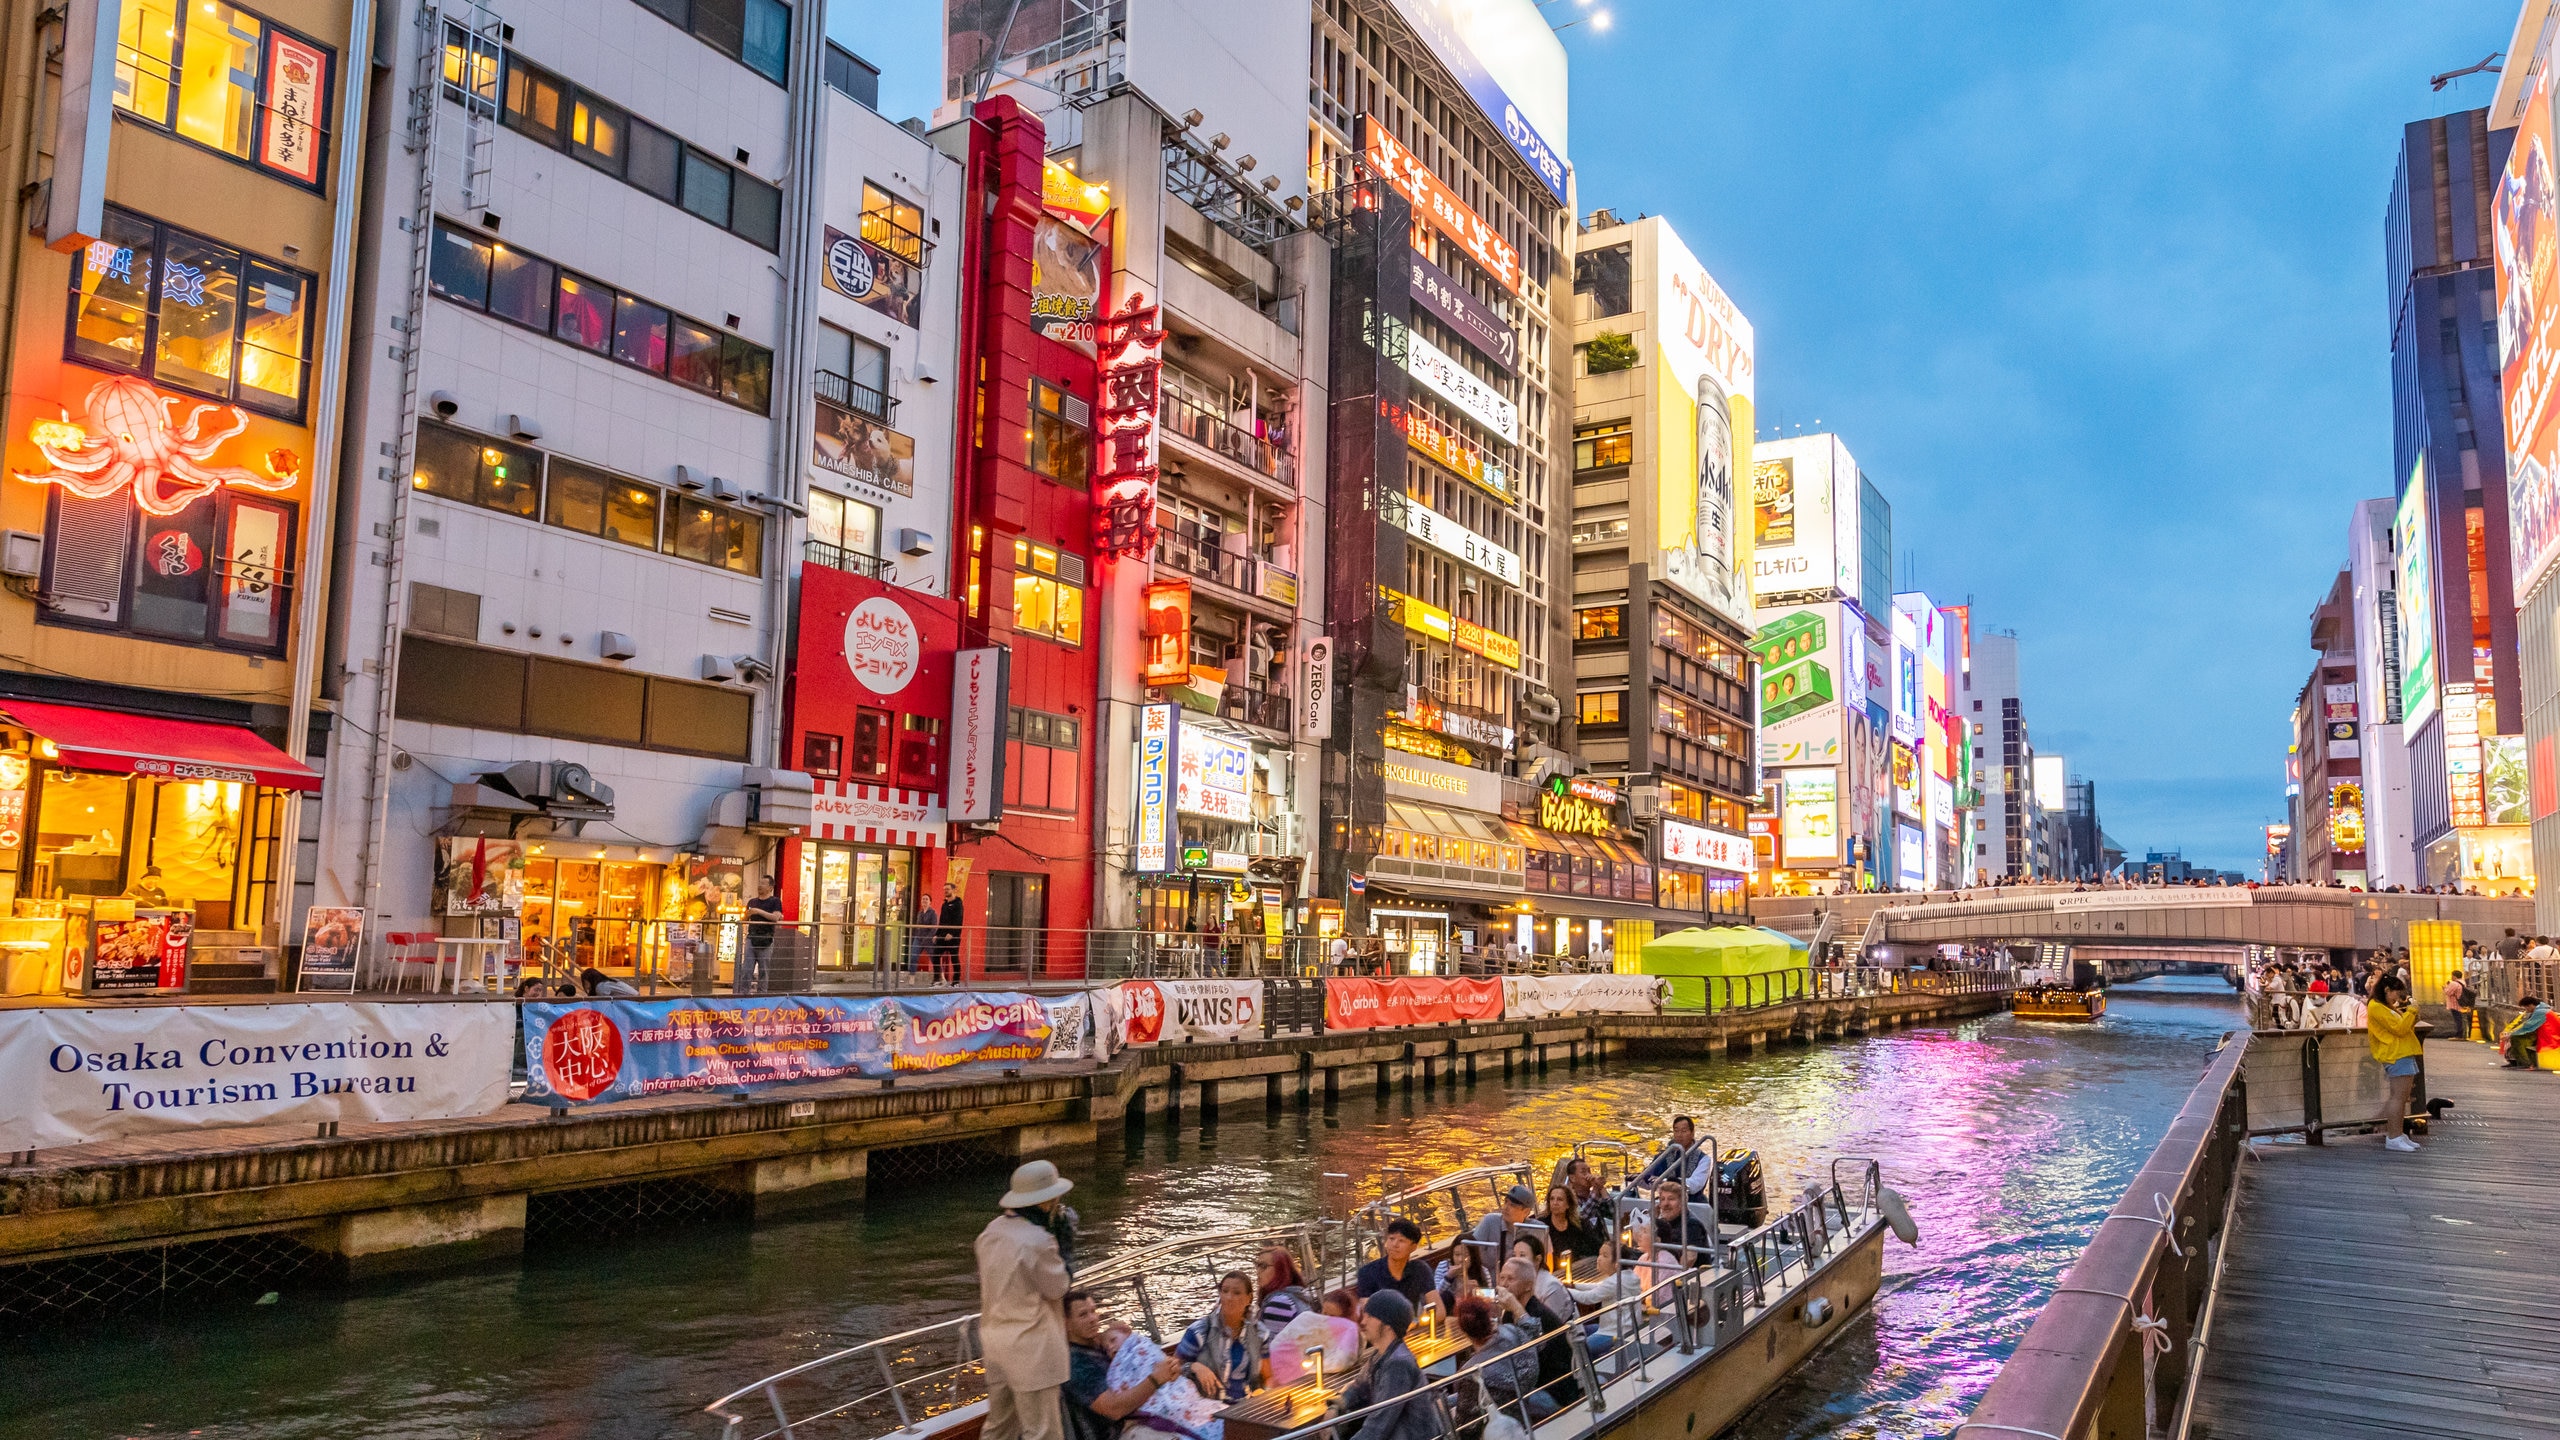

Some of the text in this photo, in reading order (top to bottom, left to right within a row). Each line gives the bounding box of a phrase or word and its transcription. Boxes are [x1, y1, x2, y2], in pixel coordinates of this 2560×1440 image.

[277, 87, 299, 163] まねき多幸
[1518, 119, 1562, 190] フジ住宅
[1433, 191, 1465, 235] 居楽屋
[1699, 272, 1733, 327] SUPER
[817, 454, 911, 496] MAMESHIBA CAFE
[1699, 449, 1732, 511] Asahi
[1711, 510, 1721, 532] 生
[1465, 533, 1507, 578] 白木屋
[236, 592, 266, 604] KUKURU
[856, 611, 909, 638] よしもと
[856, 631, 909, 658] エンタメ
[854, 652, 908, 679] ショップ
[1310, 663, 1322, 701] ZERO
[963, 653, 981, 815] よしもとエンタメショップ
[1146, 707, 1165, 732] 薬
[1145, 737, 1165, 806] ダイコク
[1203, 743, 1246, 777] ダイコク
[1430, 773, 1468, 795] COFFEE
[814, 800, 928, 822] よしもとエンタメショップ
[1200, 788, 1229, 815] 免税
[1541, 792, 1609, 837] びっくりドンキー
[1139, 844, 1165, 859] 免税
[668, 1008, 744, 1026] 大阪市中央区
[1177, 997, 1232, 1026] VANS
[1352, 996, 1379, 1010] airbnb
[49, 1032, 450, 1074] Osaka Convention &
[553, 1022, 606, 1064] 大阪
[685, 1038, 829, 1058] Osaka Chuo Ward Official Site
[559, 1051, 609, 1087] 中心
[706, 1053, 809, 1073] Why not visit the fun,
[102, 1071, 417, 1113] Tourism Bureau
[643, 1076, 706, 1093] informative
[708, 1073, 739, 1087] Osaka
[740, 1070, 767, 1084] chuo
[802, 1067, 817, 1080] the
[818, 1066, 842, 1078] latest
